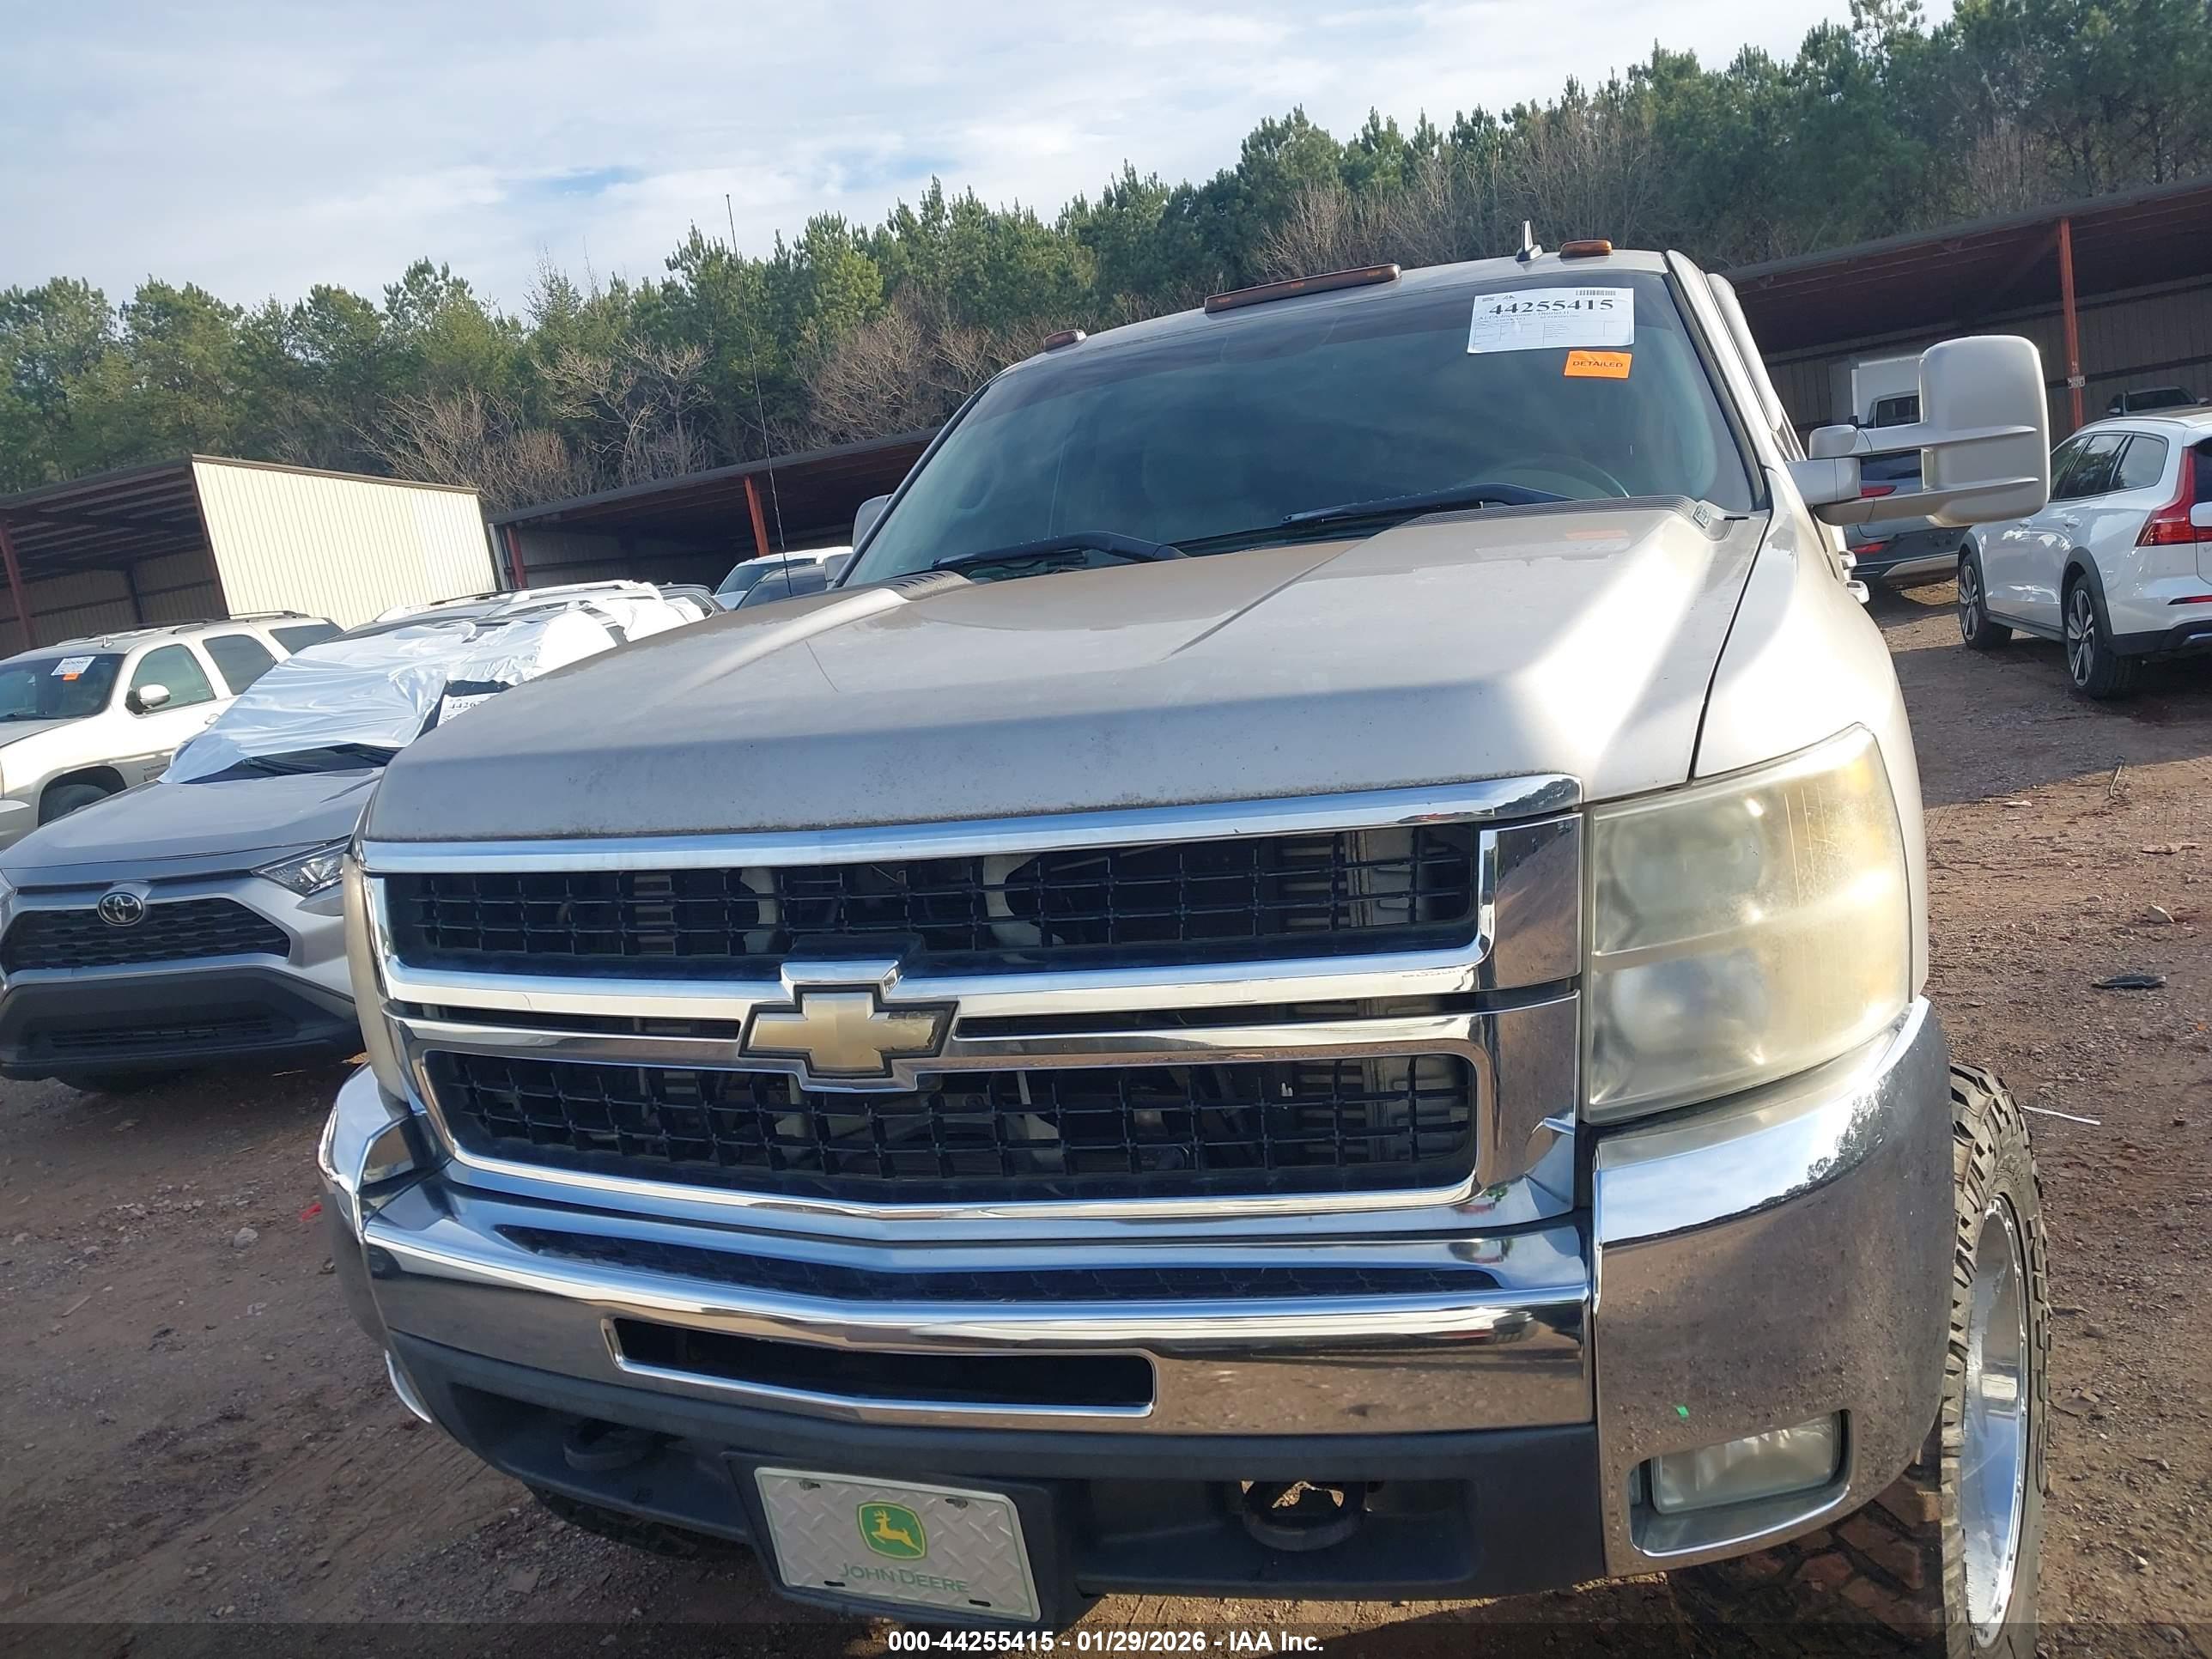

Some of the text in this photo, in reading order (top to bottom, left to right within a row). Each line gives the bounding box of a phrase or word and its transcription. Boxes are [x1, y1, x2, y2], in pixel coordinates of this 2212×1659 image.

[1489, 299, 1613, 314] 44255415
[840, 1563, 969, 1593] JOHN DEERE
